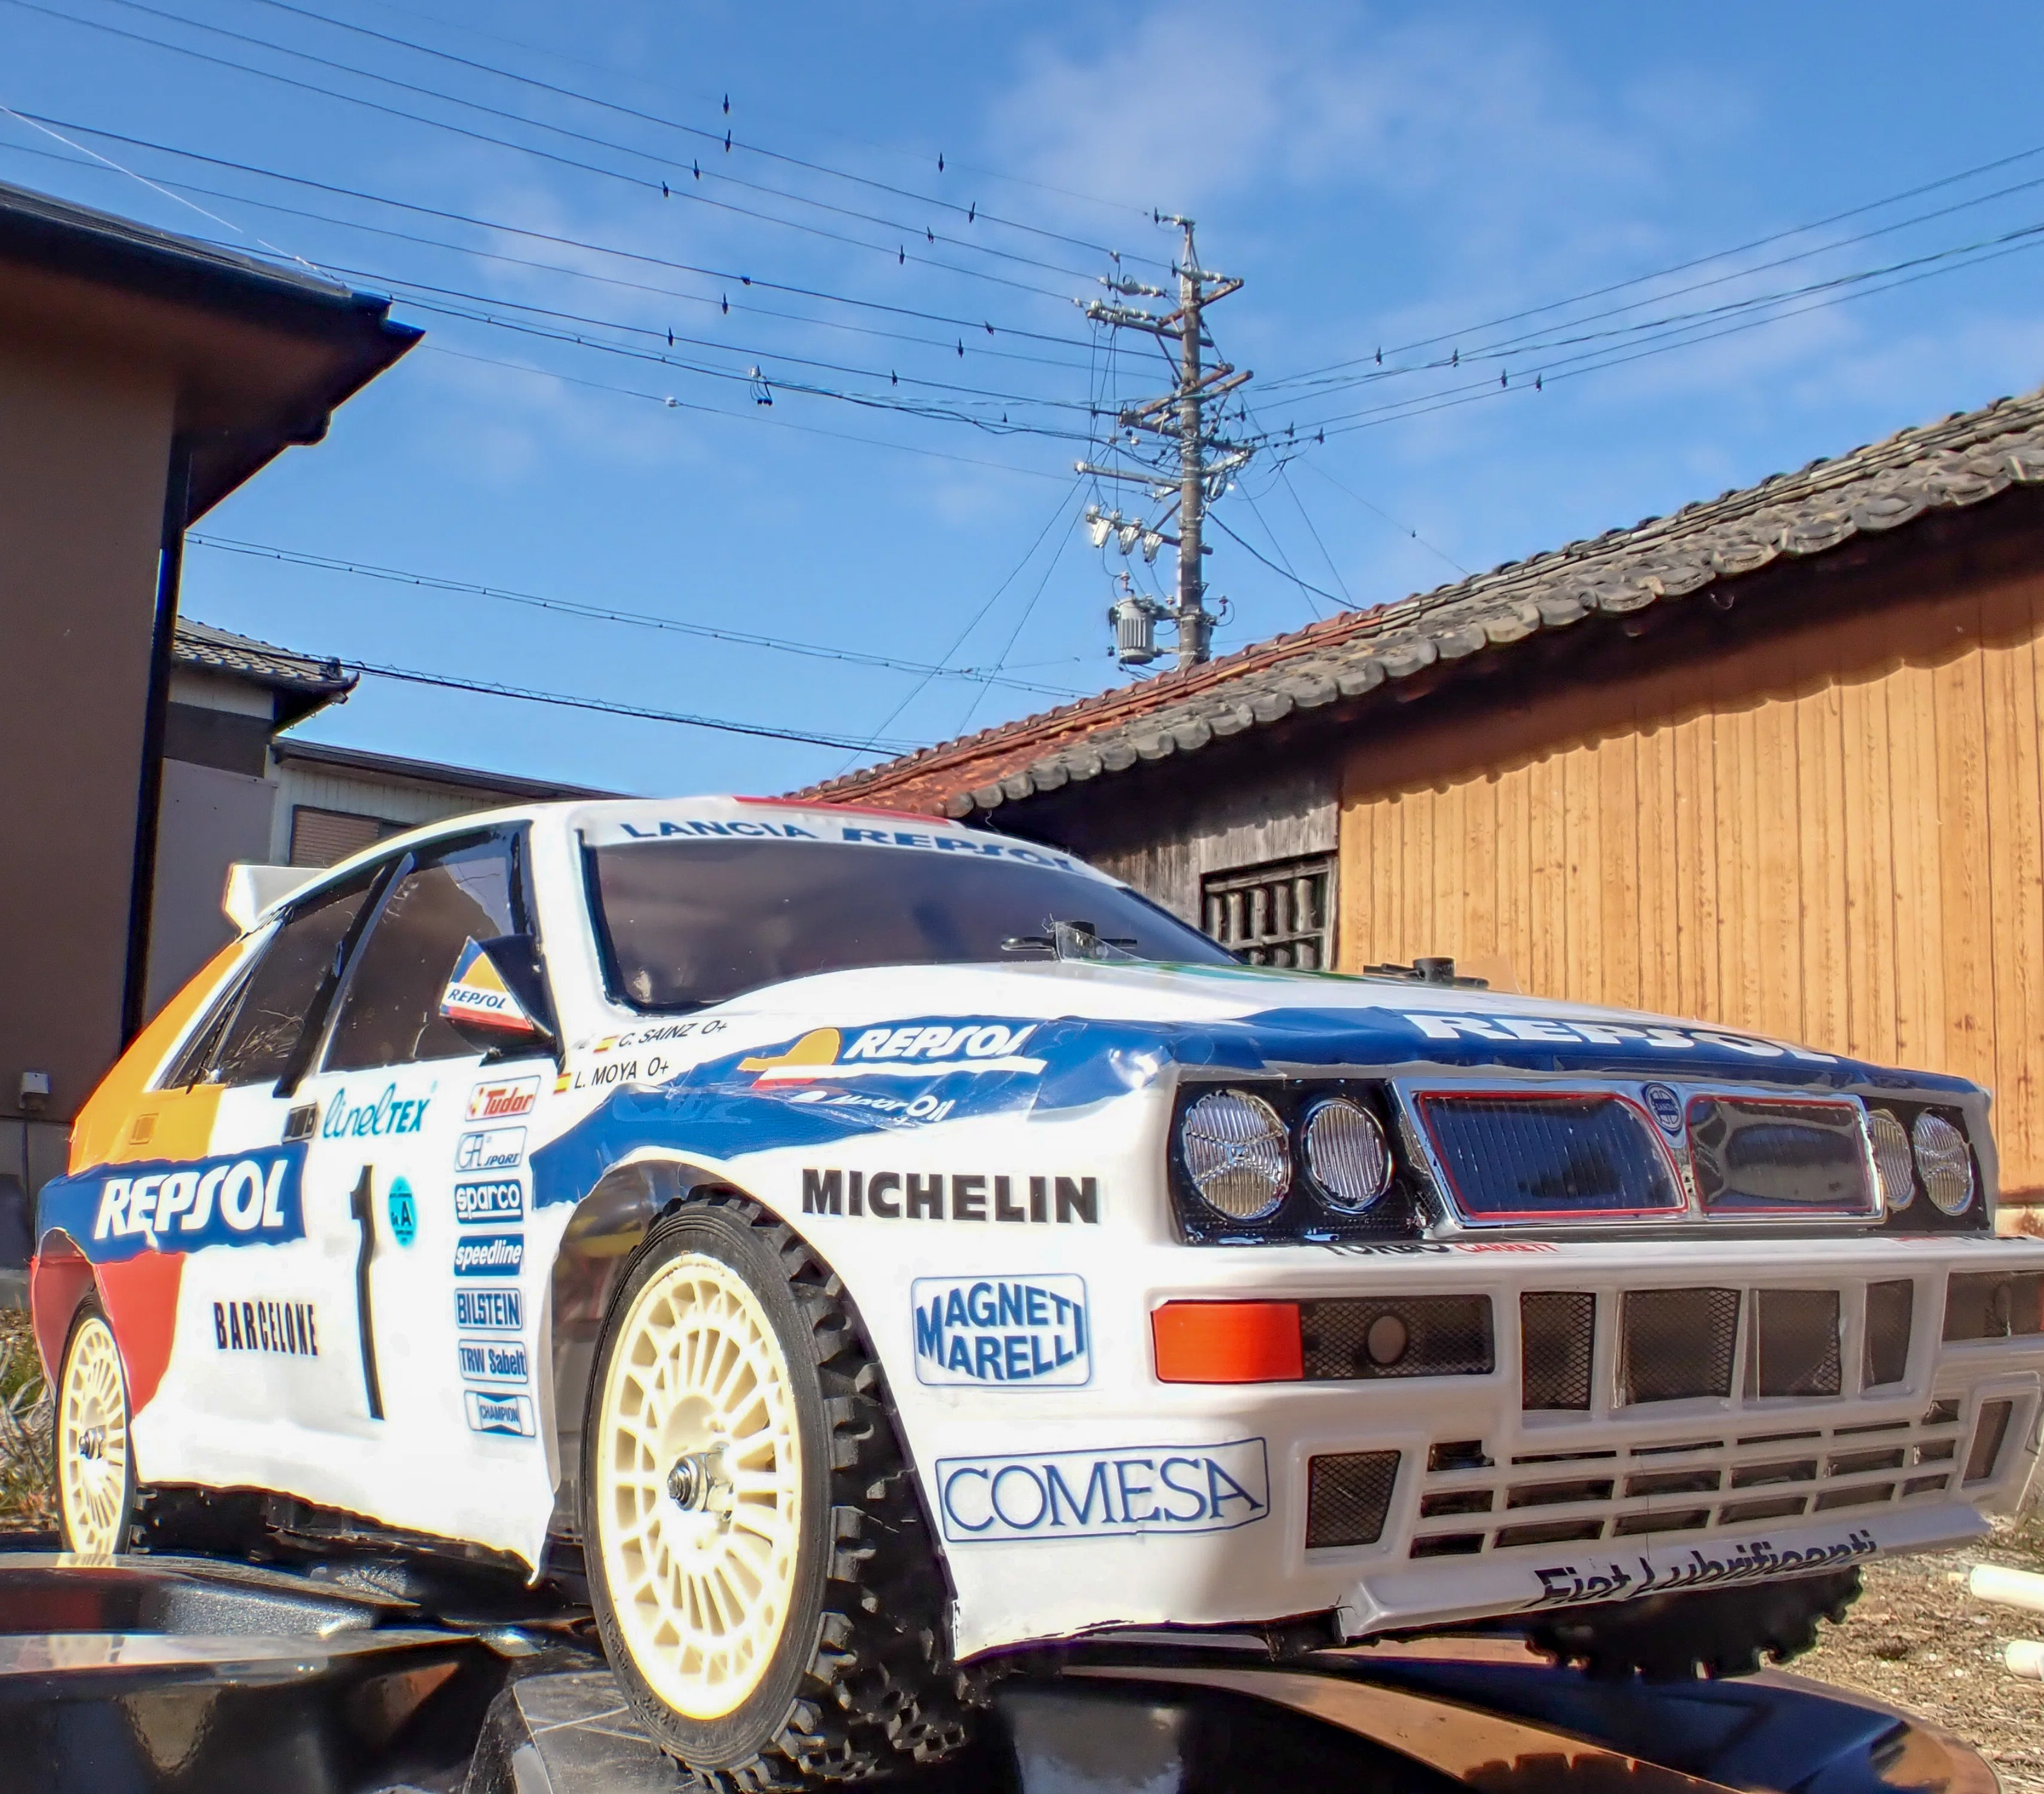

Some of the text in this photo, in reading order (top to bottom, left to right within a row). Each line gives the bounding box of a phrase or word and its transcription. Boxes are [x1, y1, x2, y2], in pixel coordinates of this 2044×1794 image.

[620, 821, 1084, 875] LANCIA REPSOL
[448, 988, 507, 1009] REPSOL
[619, 1032, 635, 1047] C.
[638, 1023, 698, 1044] SAINZ
[844, 1023, 1037, 1060] REPSOL
[1402, 1014, 1838, 1064] REPSOL
[574, 1071, 585, 1089] L.
[591, 1060, 637, 1086] MOYA
[484, 1087, 534, 1116] Tudor
[484, 1153, 520, 1167] SPORT
[94, 1160, 289, 1240] REPSOL
[456, 1183, 520, 1220] sparco
[802, 1168, 1099, 1225] MICHELIN
[401, 1200, 412, 1226] A
[456, 1239, 522, 1271] speedline
[350, 1164, 386, 1421] 1
[457, 1293, 520, 1325] BILSTEIN
[213, 1301, 318, 1356] BARCELONE
[460, 1347, 527, 1375] TRW Sabelt
[480, 1404, 519, 1422] CHAMPION
[944, 1457, 1265, 1531] COMESA
